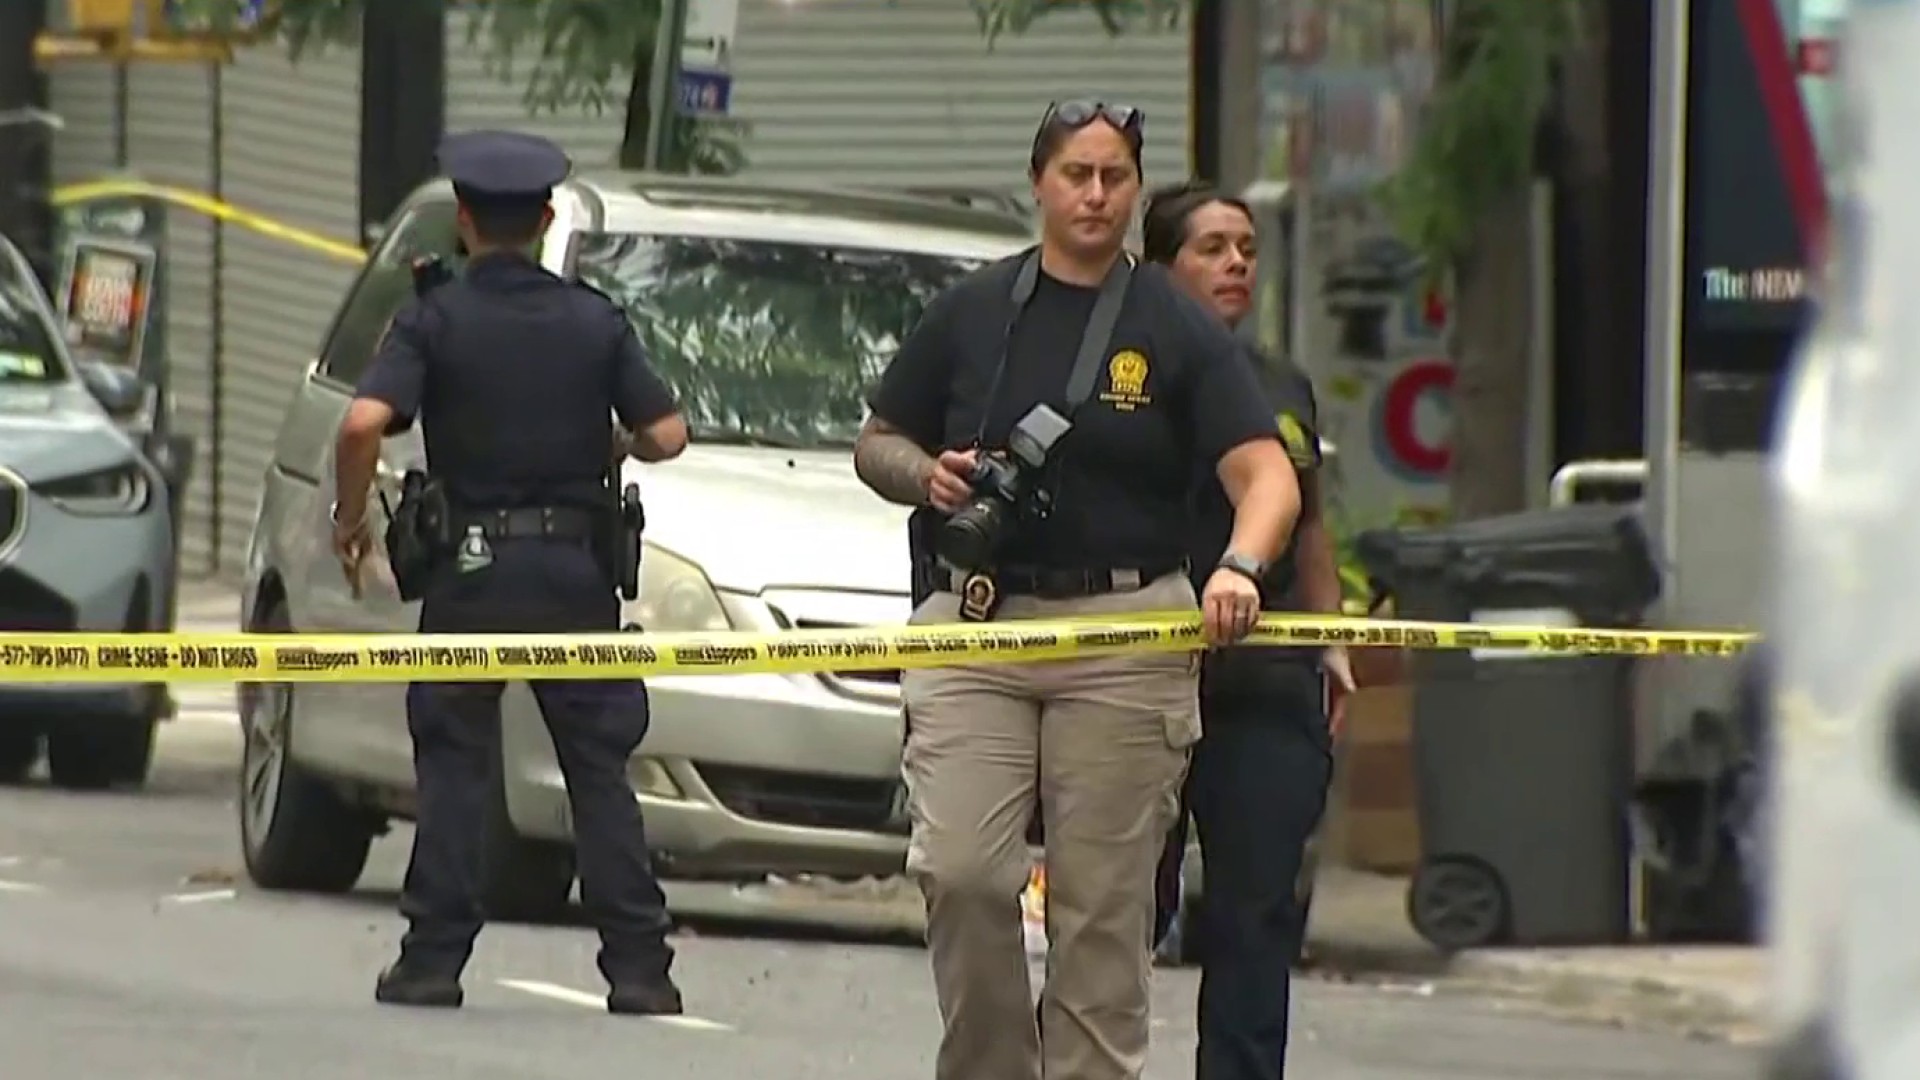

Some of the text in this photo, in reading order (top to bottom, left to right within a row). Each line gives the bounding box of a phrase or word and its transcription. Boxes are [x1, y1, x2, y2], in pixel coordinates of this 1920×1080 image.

[98, 646, 131, 668] CRIME
[134, 646, 168, 668] SCENE
[180, 646, 196, 668] DO
[198, 646, 219, 668] NOT
[221, 646, 258, 668] CROSS
[496, 647, 532, 666] CRIME
[533, 646, 568, 666] SCENE
[578, 645, 594, 665] DO
[595, 645, 617, 665] NOT
[618, 644, 657, 664] CROSS
